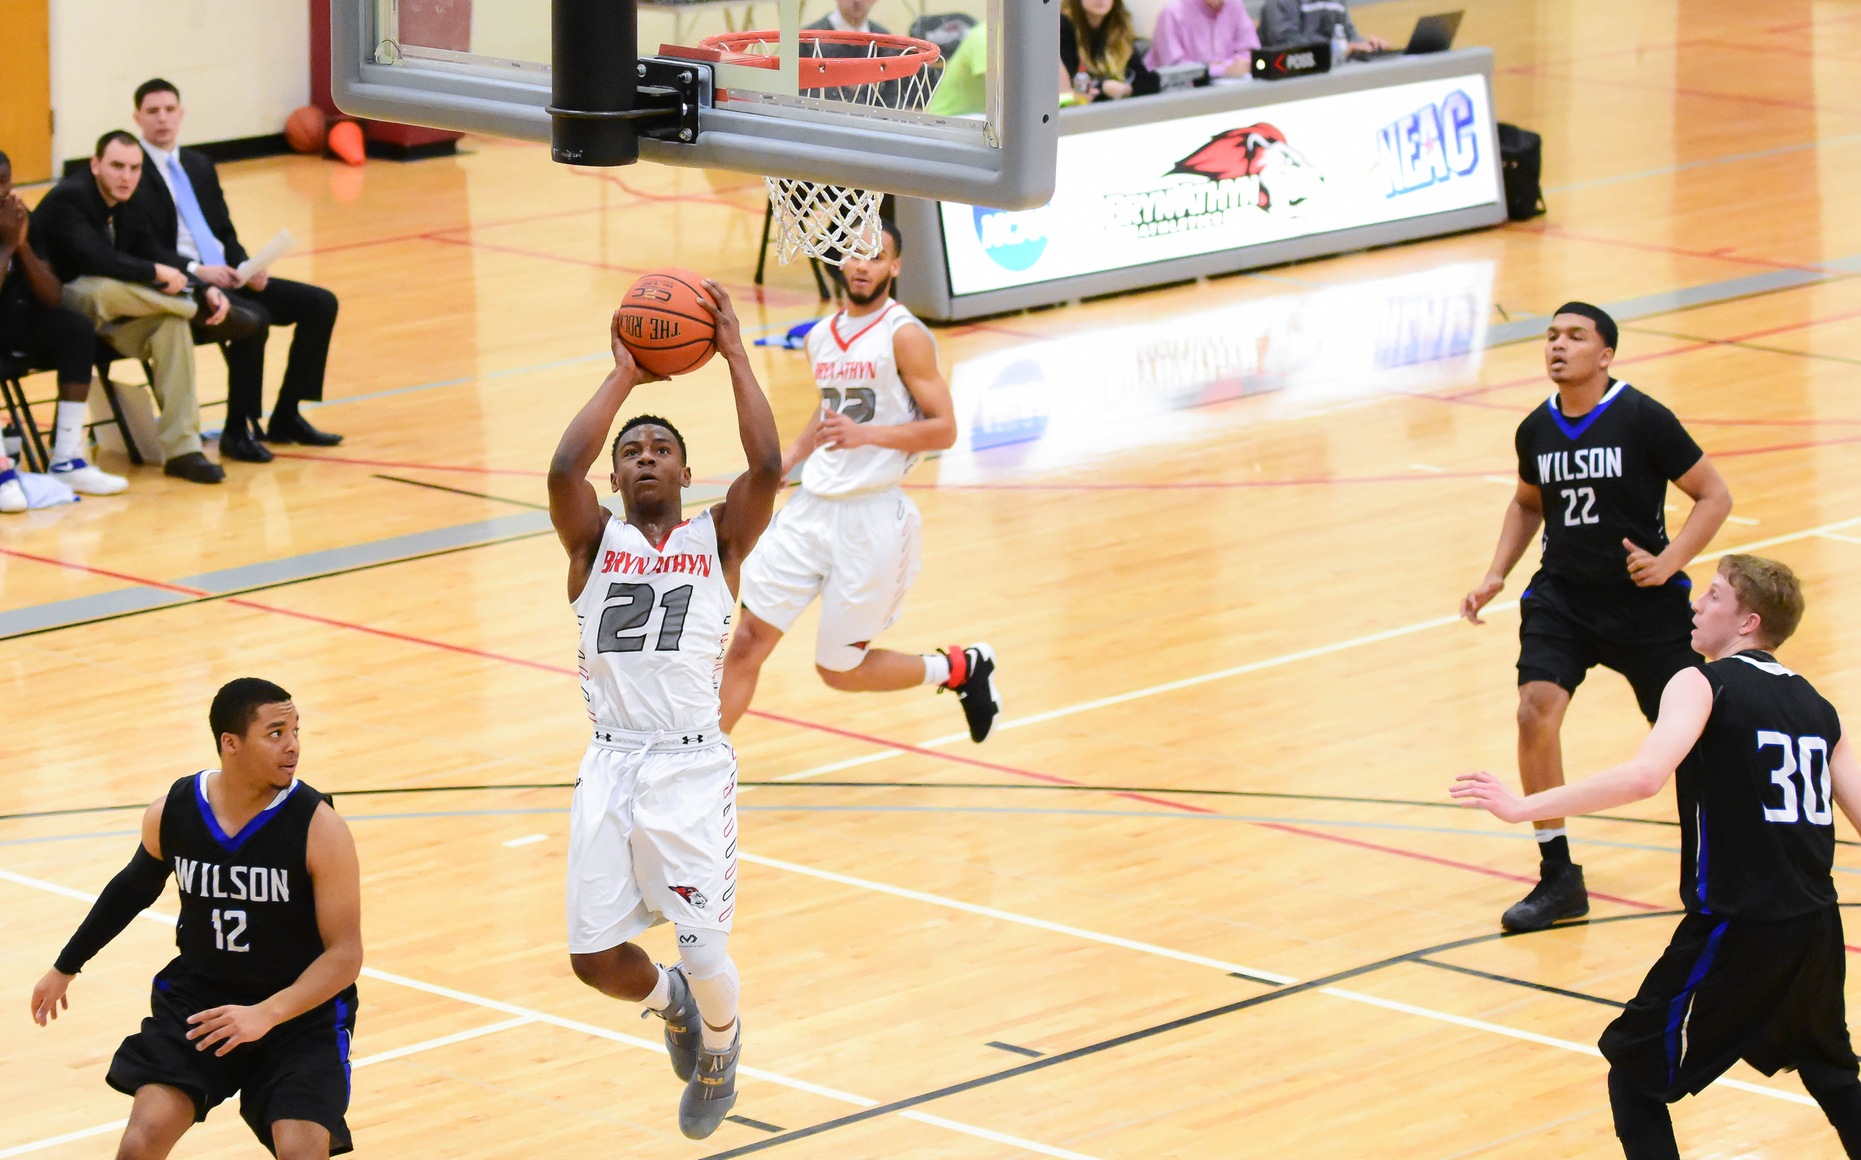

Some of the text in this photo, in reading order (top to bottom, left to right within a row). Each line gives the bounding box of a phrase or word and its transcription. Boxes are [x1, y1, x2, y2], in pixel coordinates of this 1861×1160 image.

[1376, 88, 1479, 199] NEAC
[649, 317, 681, 340] THE
[837, 361, 876, 380] ATHYN
[1537, 446, 1622, 484] WILSON
[1560, 486, 1600, 527] 22
[601, 550, 713, 578] BRYN ATHYN
[596, 582, 694, 654] 21
[1756, 729, 1832, 826] 30
[174, 855, 290, 902] WILSON
[211, 908, 250, 953] 12
